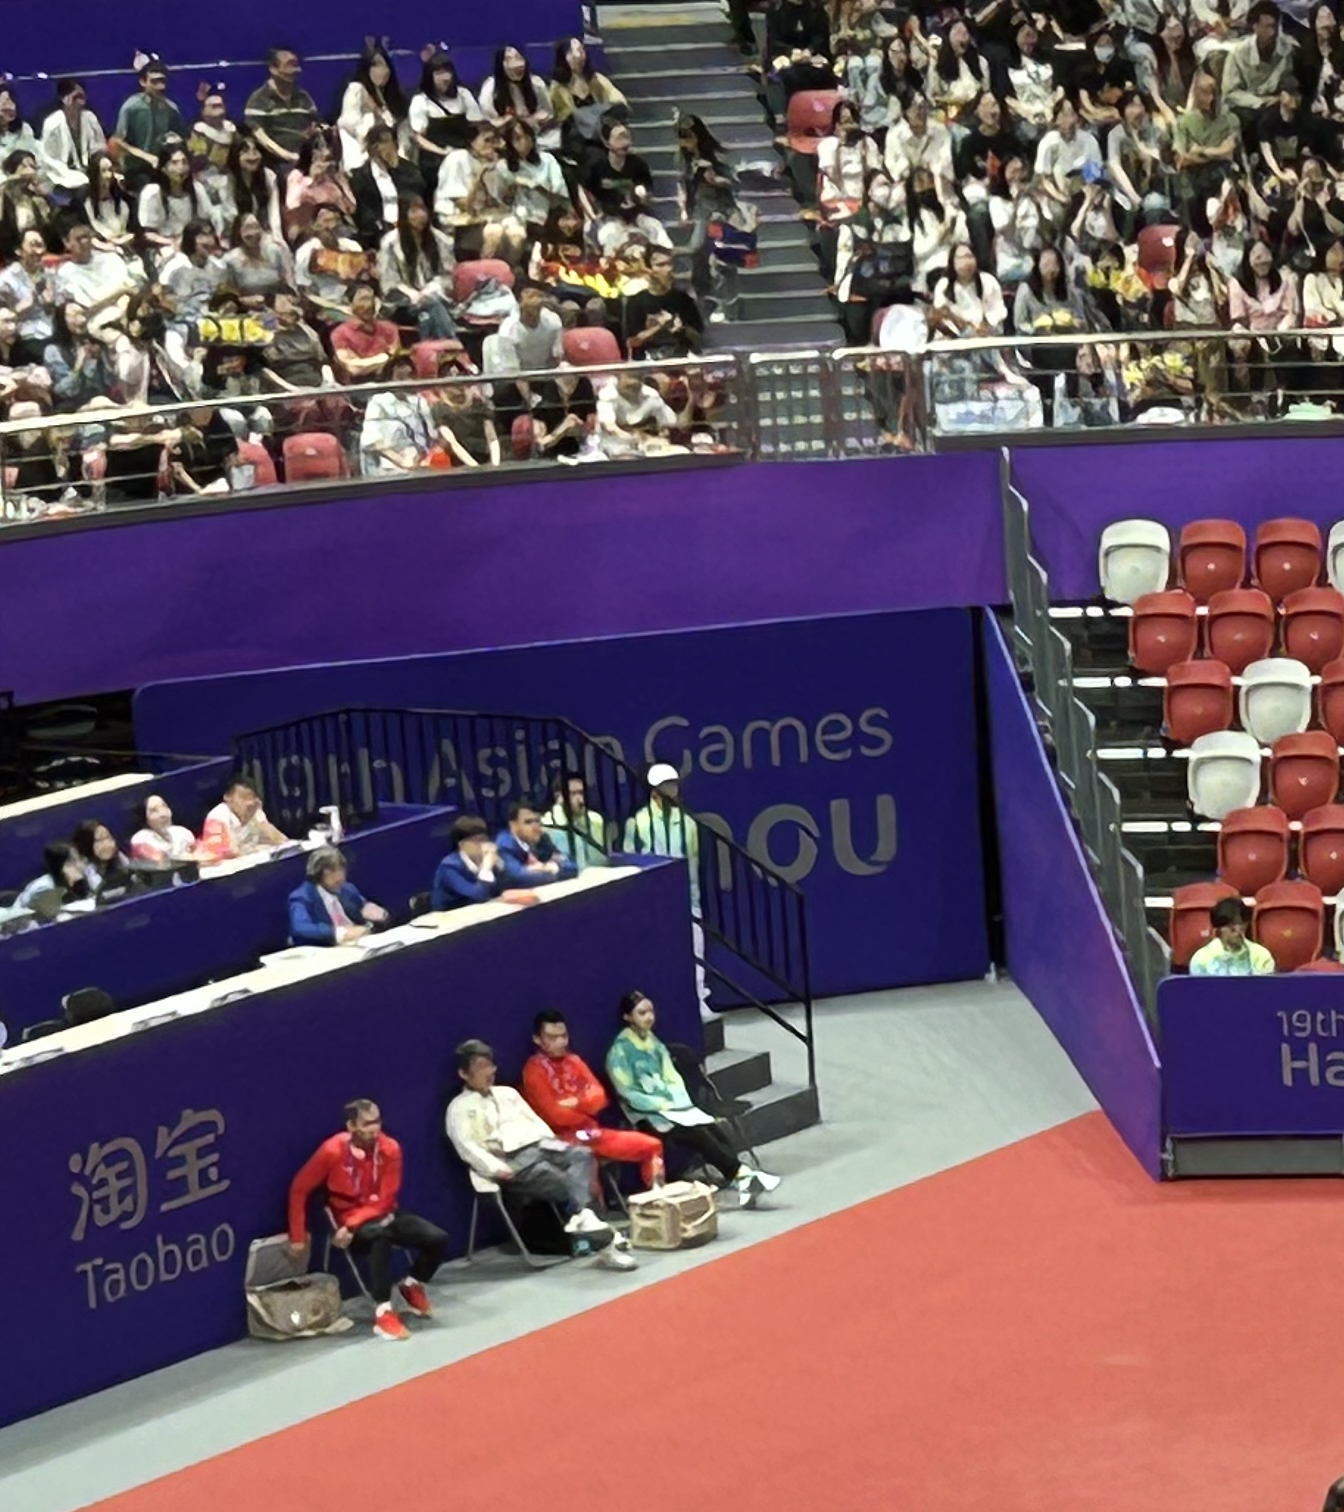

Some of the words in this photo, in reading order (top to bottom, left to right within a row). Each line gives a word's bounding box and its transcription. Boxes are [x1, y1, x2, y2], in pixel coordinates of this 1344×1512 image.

[644, 707, 893, 780] Games
[69, 1109, 231, 1241] 淘宝
[75, 1223, 235, 1309] Taobao
